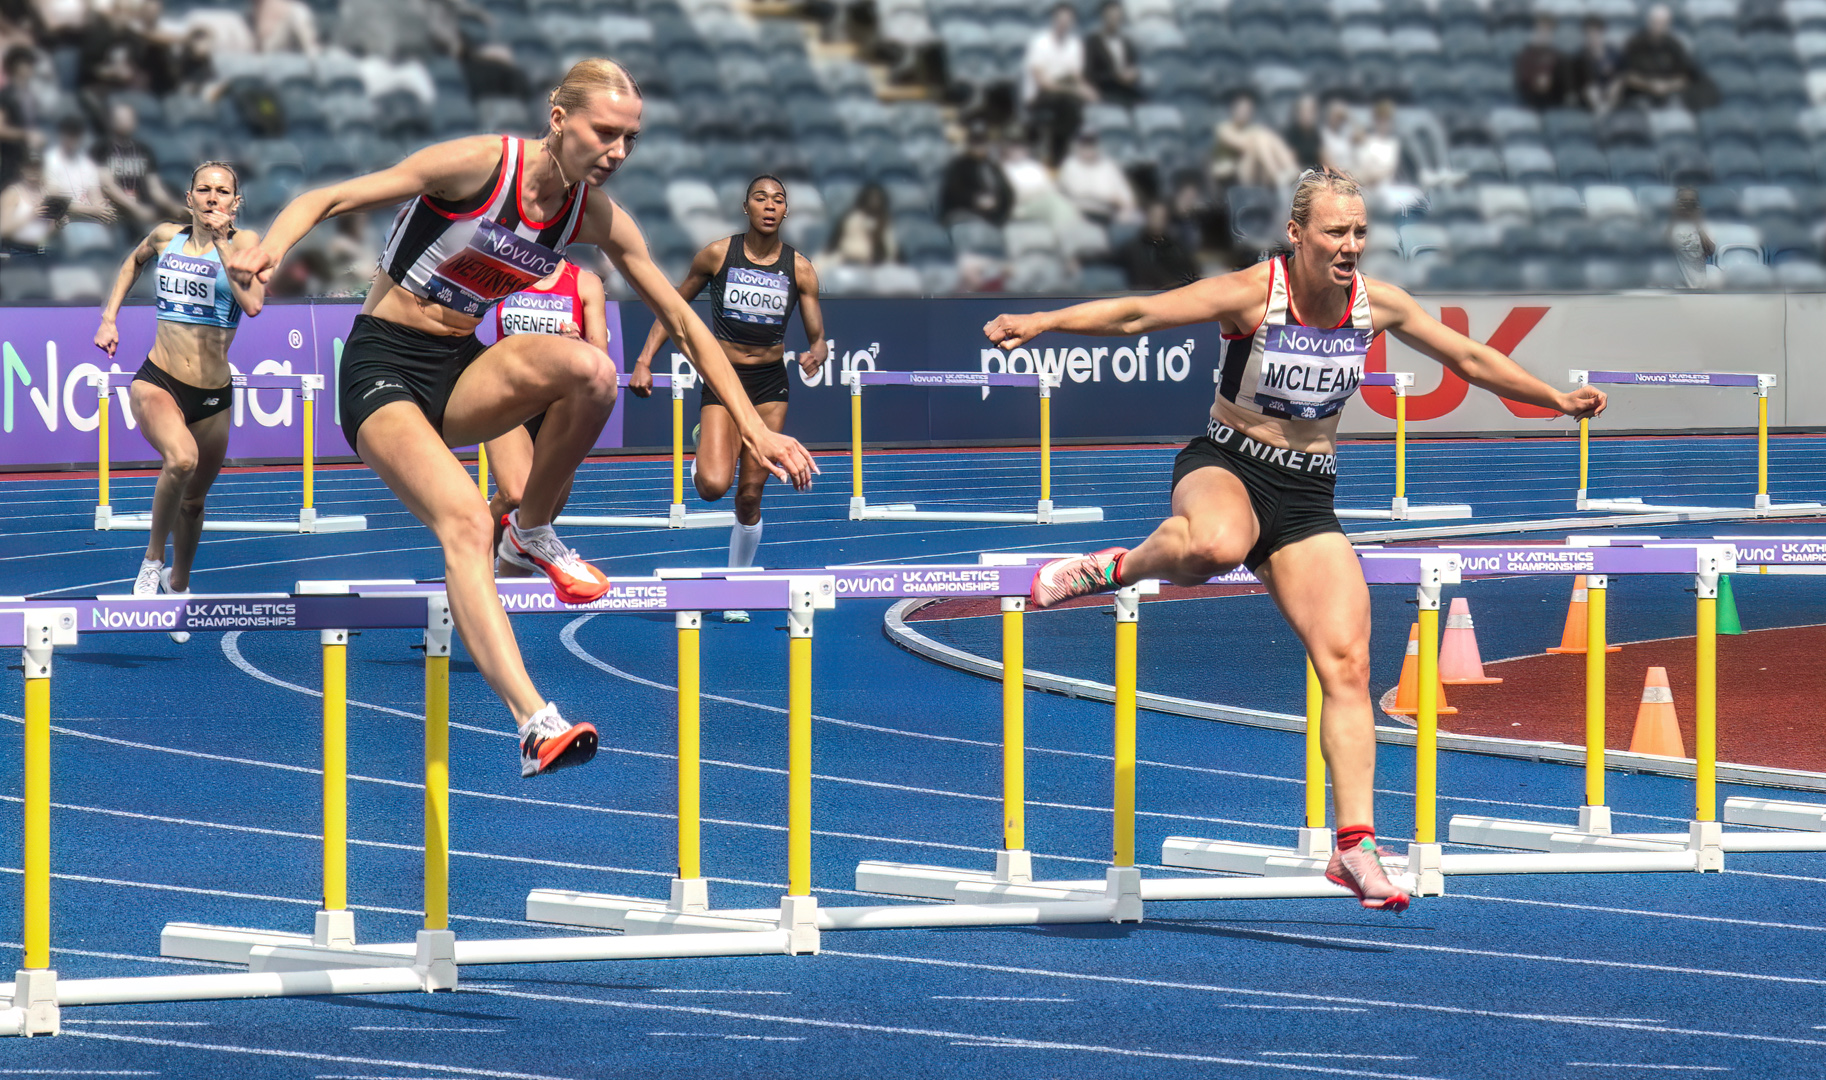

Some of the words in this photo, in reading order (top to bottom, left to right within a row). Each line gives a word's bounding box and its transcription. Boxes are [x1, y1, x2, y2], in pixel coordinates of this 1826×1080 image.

[483, 229, 557, 275] Novuna
[164, 255, 211, 275] Novuna
[160, 275, 208, 299] ELLISS
[733, 271, 781, 289] Novuna
[510, 295, 564, 310] Novuna
[729, 289, 783, 310] OKORO
[504, 313, 565, 336] GRENFEL
[1278, 329, 1355, 354] Novuna
[981, 346, 1109, 400] power
[1112, 336, 1149, 383] of
[2, 340, 294, 432] Novna
[1264, 362, 1360, 393] MCLEAN
[1239, 437, 1306, 470] NIKE
[1507, 552, 1527, 562] UK
[1528, 552, 1594, 562] ATHLETICS
[1735, 548, 1775, 561] vuna
[1782, 544, 1798, 553] UK
[1460, 557, 1499, 570] vuna
[1507, 562, 1594, 572] CHAMPIONSHIPS
[836, 577, 895, 593] ovuna
[903, 572, 922, 583] UK
[924, 571, 999, 582] ATHLETICS
[603, 586, 667, 598] HLETICS
[903, 582, 1000, 593] CHAMPIONSHIPS
[92, 607, 177, 629] Novuna
[186, 605, 207, 616] UK
[208, 604, 297, 616] ATHLETICS
[186, 617, 297, 627] CHAMPIONSHIPS
